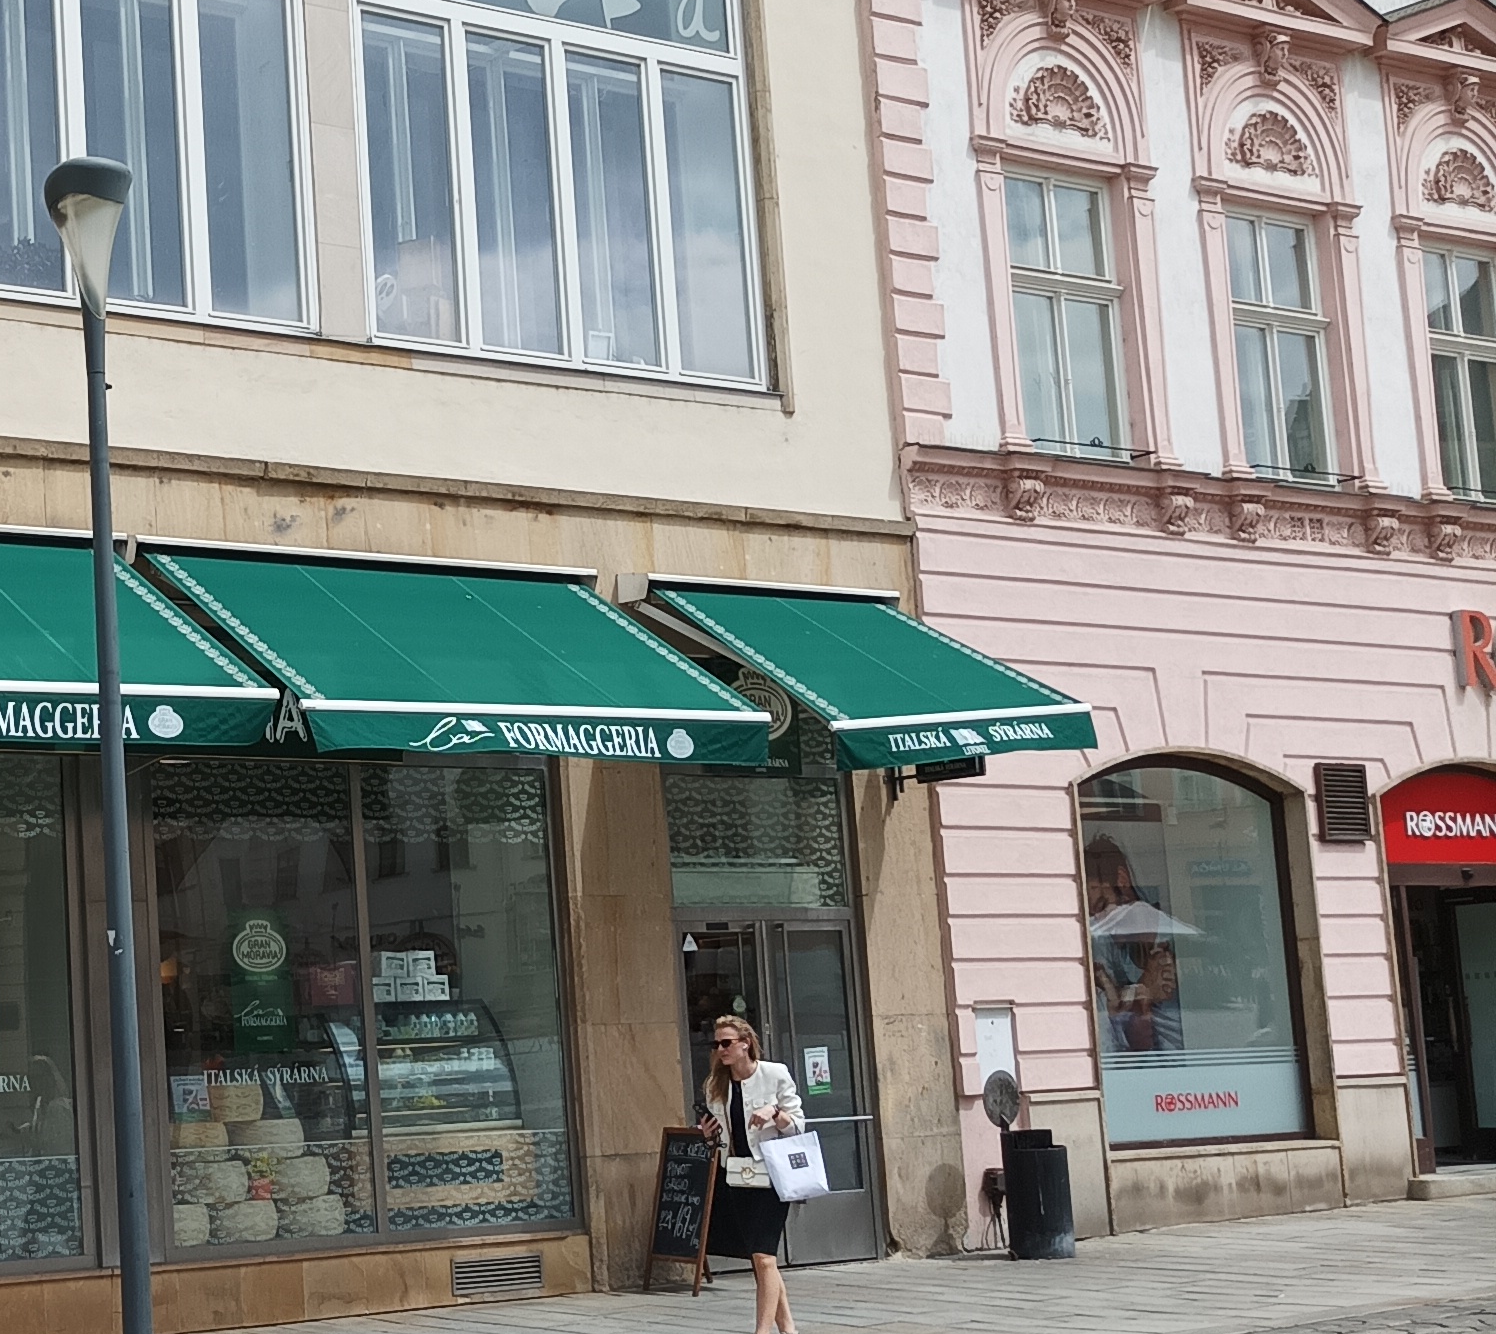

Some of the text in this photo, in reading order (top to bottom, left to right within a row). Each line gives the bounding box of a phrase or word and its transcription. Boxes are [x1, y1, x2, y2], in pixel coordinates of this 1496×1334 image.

[497, 721, 662, 759] FORMAGGERIA
[888, 721, 1054, 752] ITALSKÁ SÝRÁRNA
[241, 950, 279, 961] MORAVIA
[247, 939, 271, 950] GRAN
[203, 1064, 261, 1087] ITALSKÁ
[267, 1063, 329, 1084] SÝRÁRNA
[1154, 1090, 1239, 1112] ROSSMANN
